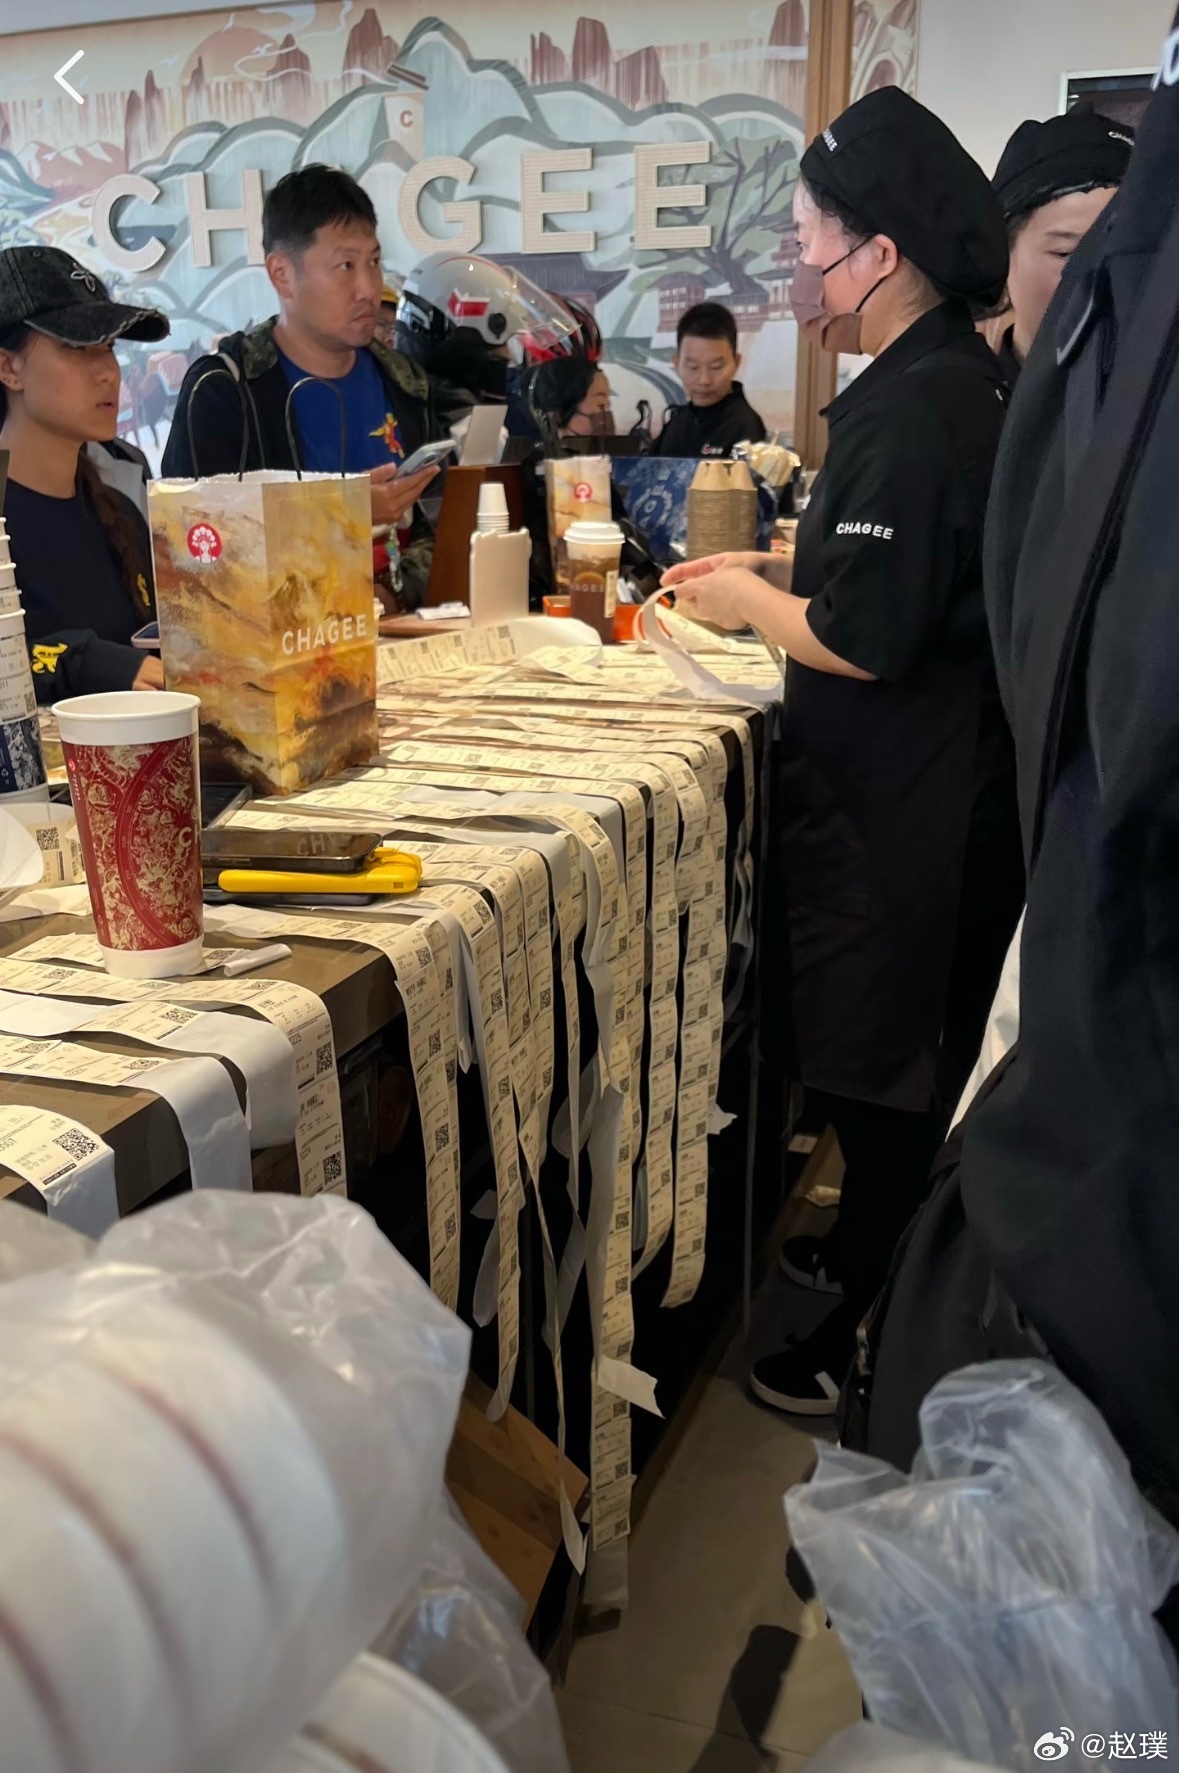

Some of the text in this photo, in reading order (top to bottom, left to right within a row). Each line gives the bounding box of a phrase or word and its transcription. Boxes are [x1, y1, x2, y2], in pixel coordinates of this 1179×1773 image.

[92, 141, 713, 272] CHGEE
[835, 521, 895, 540] CHAGEE
[282, 614, 368, 656] CHAGEE
